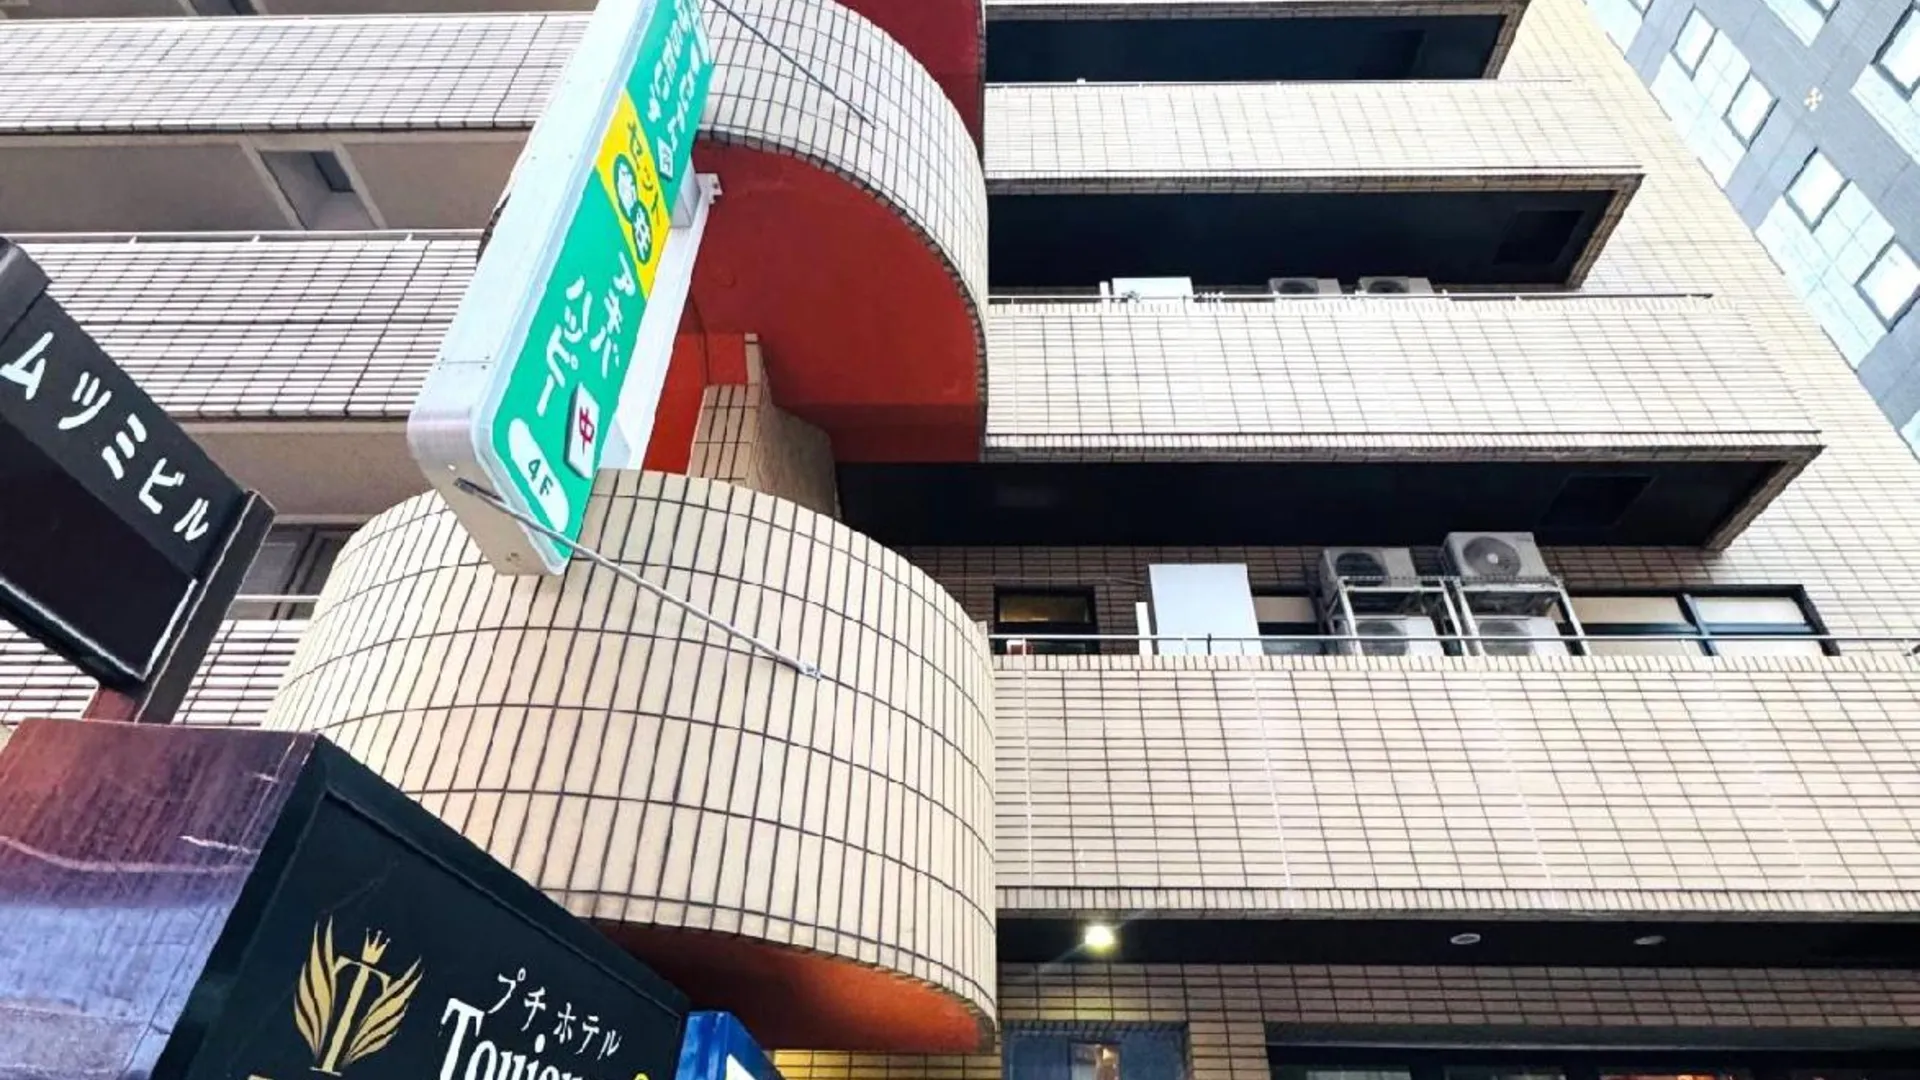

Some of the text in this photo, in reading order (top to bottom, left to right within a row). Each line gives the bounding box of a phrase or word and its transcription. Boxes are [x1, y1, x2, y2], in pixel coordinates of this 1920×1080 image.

[537, 276, 592, 417] ハッピー
[590, 252, 636, 378] アキバ
[0, 332, 209, 541] ムツミビル
[527, 458, 554, 496] 4F
[488, 967, 623, 1060] プチホテル
